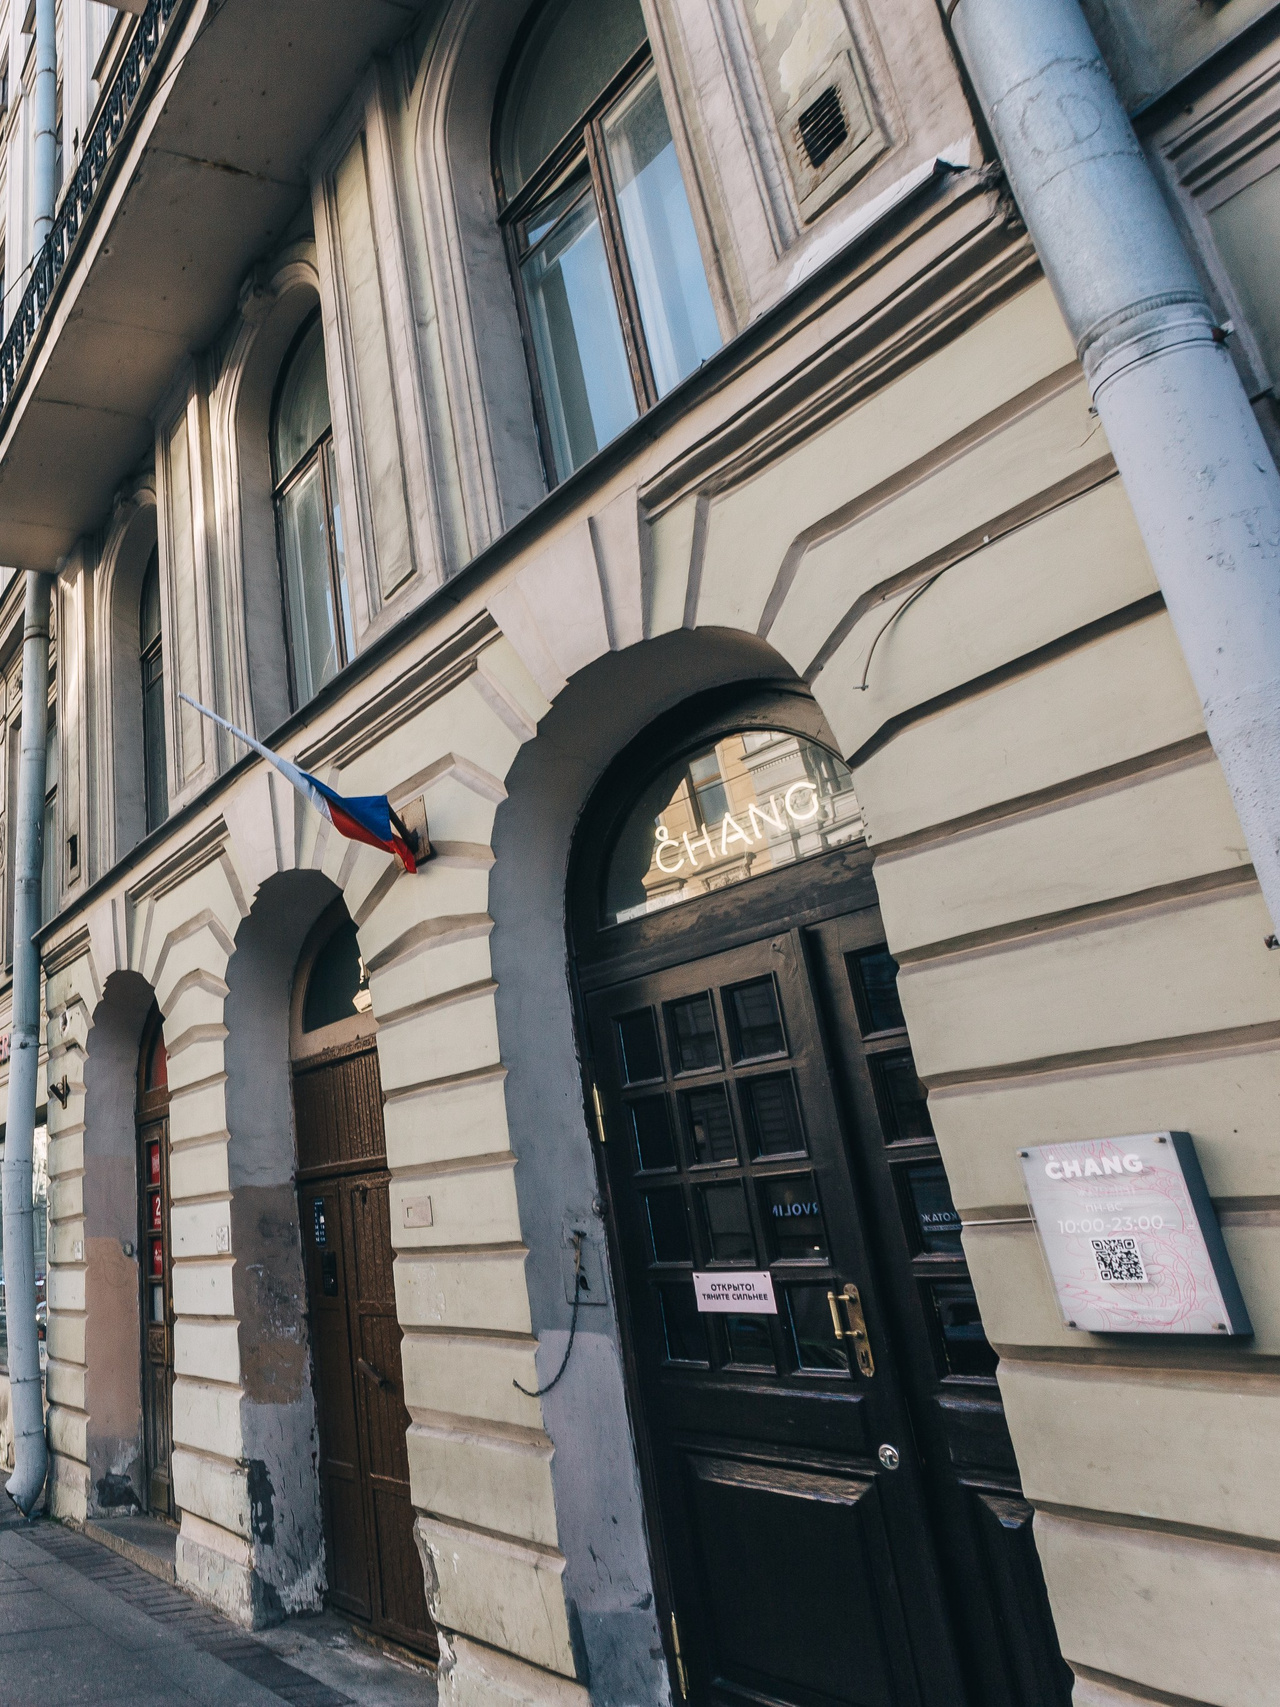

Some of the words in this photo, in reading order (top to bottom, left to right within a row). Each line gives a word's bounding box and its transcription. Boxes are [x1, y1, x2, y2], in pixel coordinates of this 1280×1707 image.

[1084, 1202, 1123, 1213] ПН-ВС
[1057, 1214, 1164, 1234] 10:00-23:00
[710, 1283, 755, 1292] ОТКРЫТО!
[702, 1293, 730, 1301] ТЯНИТЕ
[731, 1293, 769, 1301] СИЛЬНЕЕ
